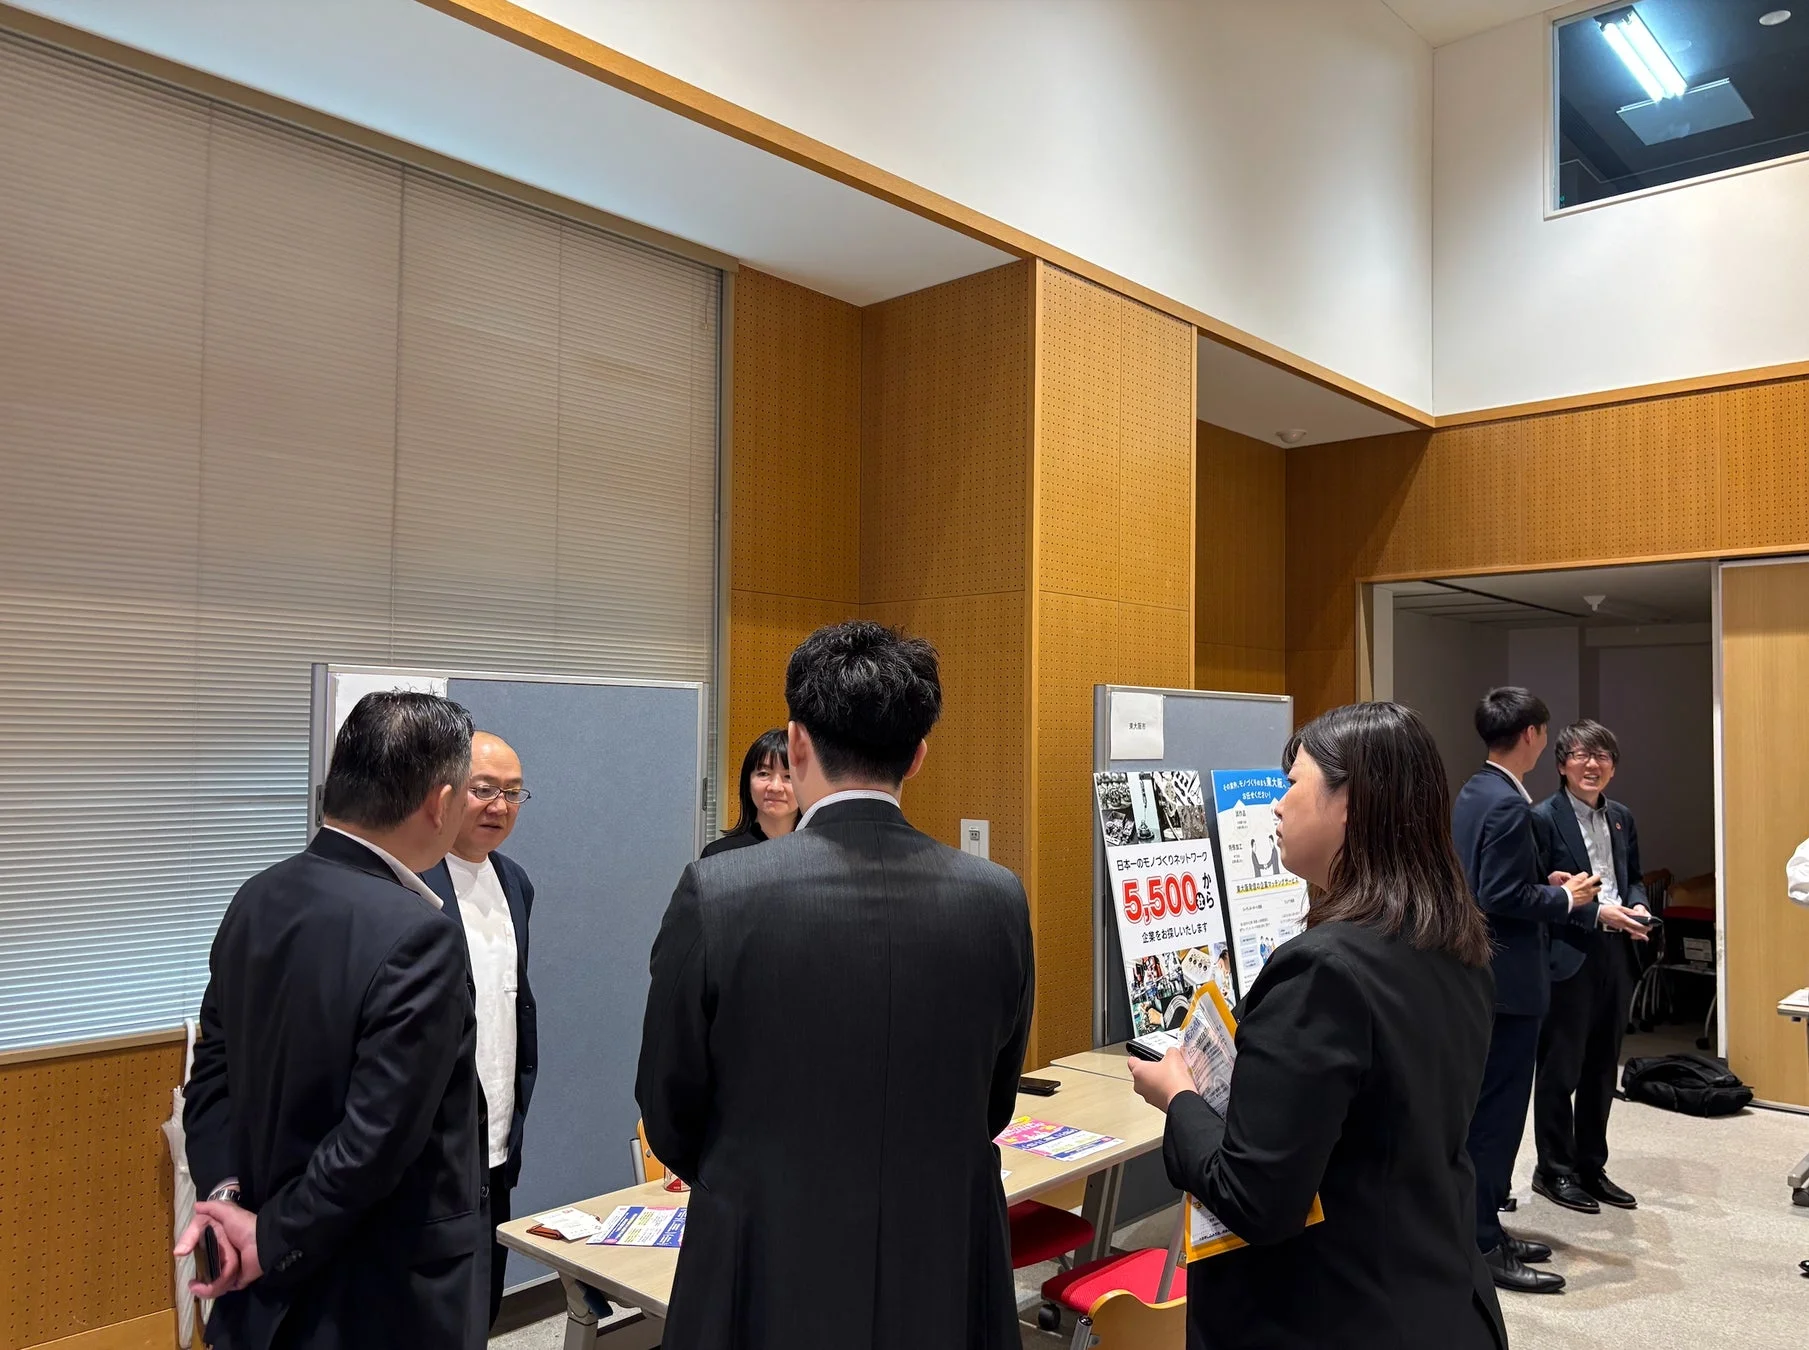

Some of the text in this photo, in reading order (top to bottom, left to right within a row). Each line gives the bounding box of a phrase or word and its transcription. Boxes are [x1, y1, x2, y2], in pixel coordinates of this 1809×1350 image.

[1117, 851, 1207, 871] 日本一のモノづくりネットワーク
[1122, 871, 1198, 926] 5,500
[1141, 922, 1208, 944] 企業をお探しいたします
